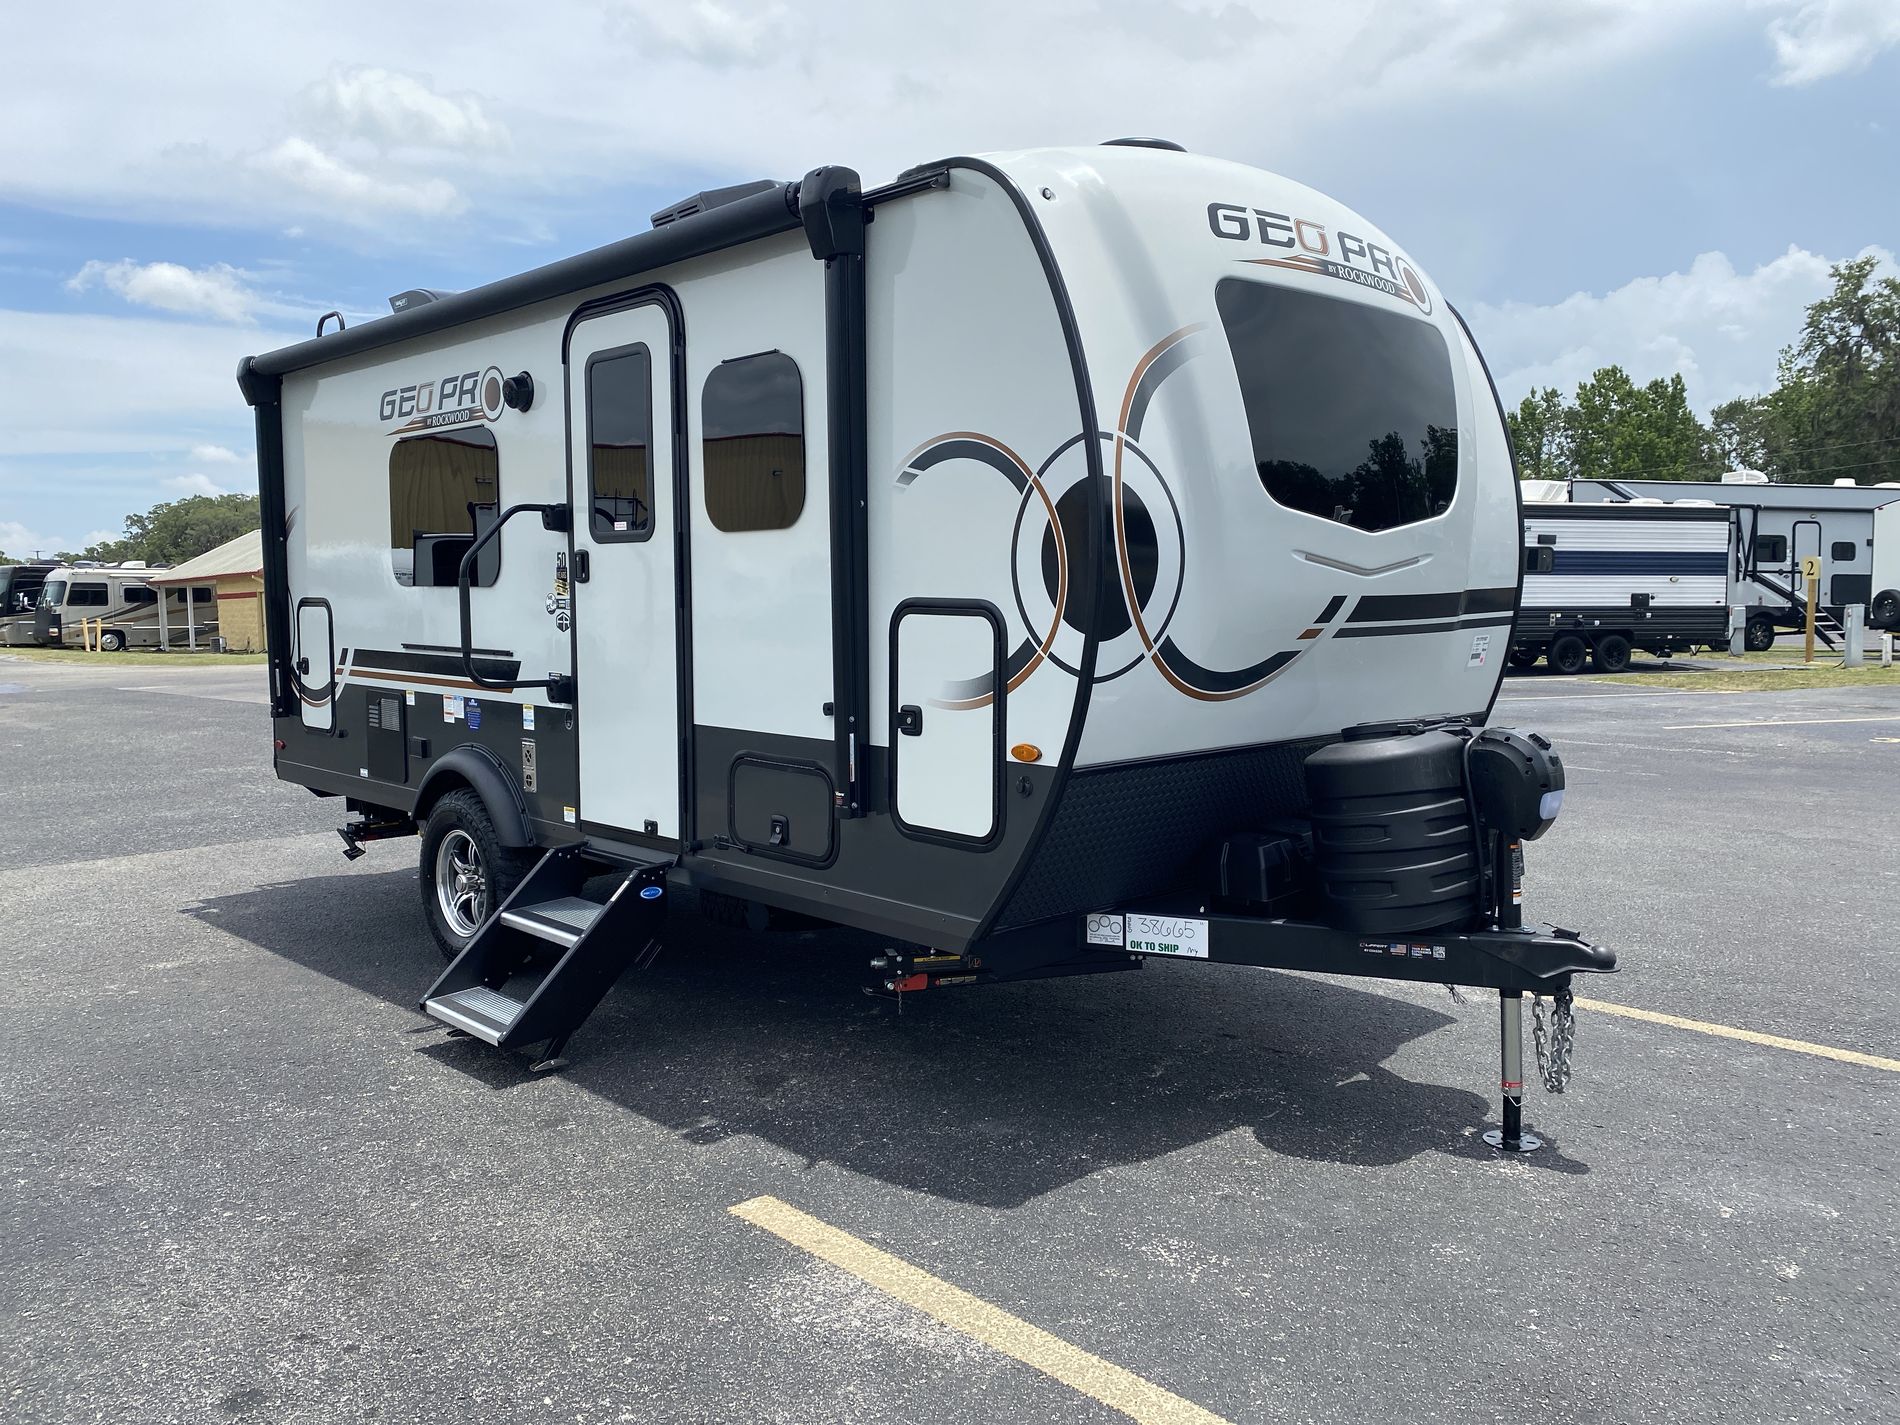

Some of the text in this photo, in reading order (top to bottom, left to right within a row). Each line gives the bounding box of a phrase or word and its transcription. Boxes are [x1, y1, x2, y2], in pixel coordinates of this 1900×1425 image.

[1207, 202, 1433, 317] GEO PRO
[1328, 264, 1396, 296] BY ROCKWOOD
[379, 365, 506, 423] GEO PRO
[432, 412, 470, 427] ROCKWOOD
[1806, 560, 1815, 576] 2
[1138, 917, 1195, 938] 38665
[1130, 940, 1179, 953] OK TO SHIP
